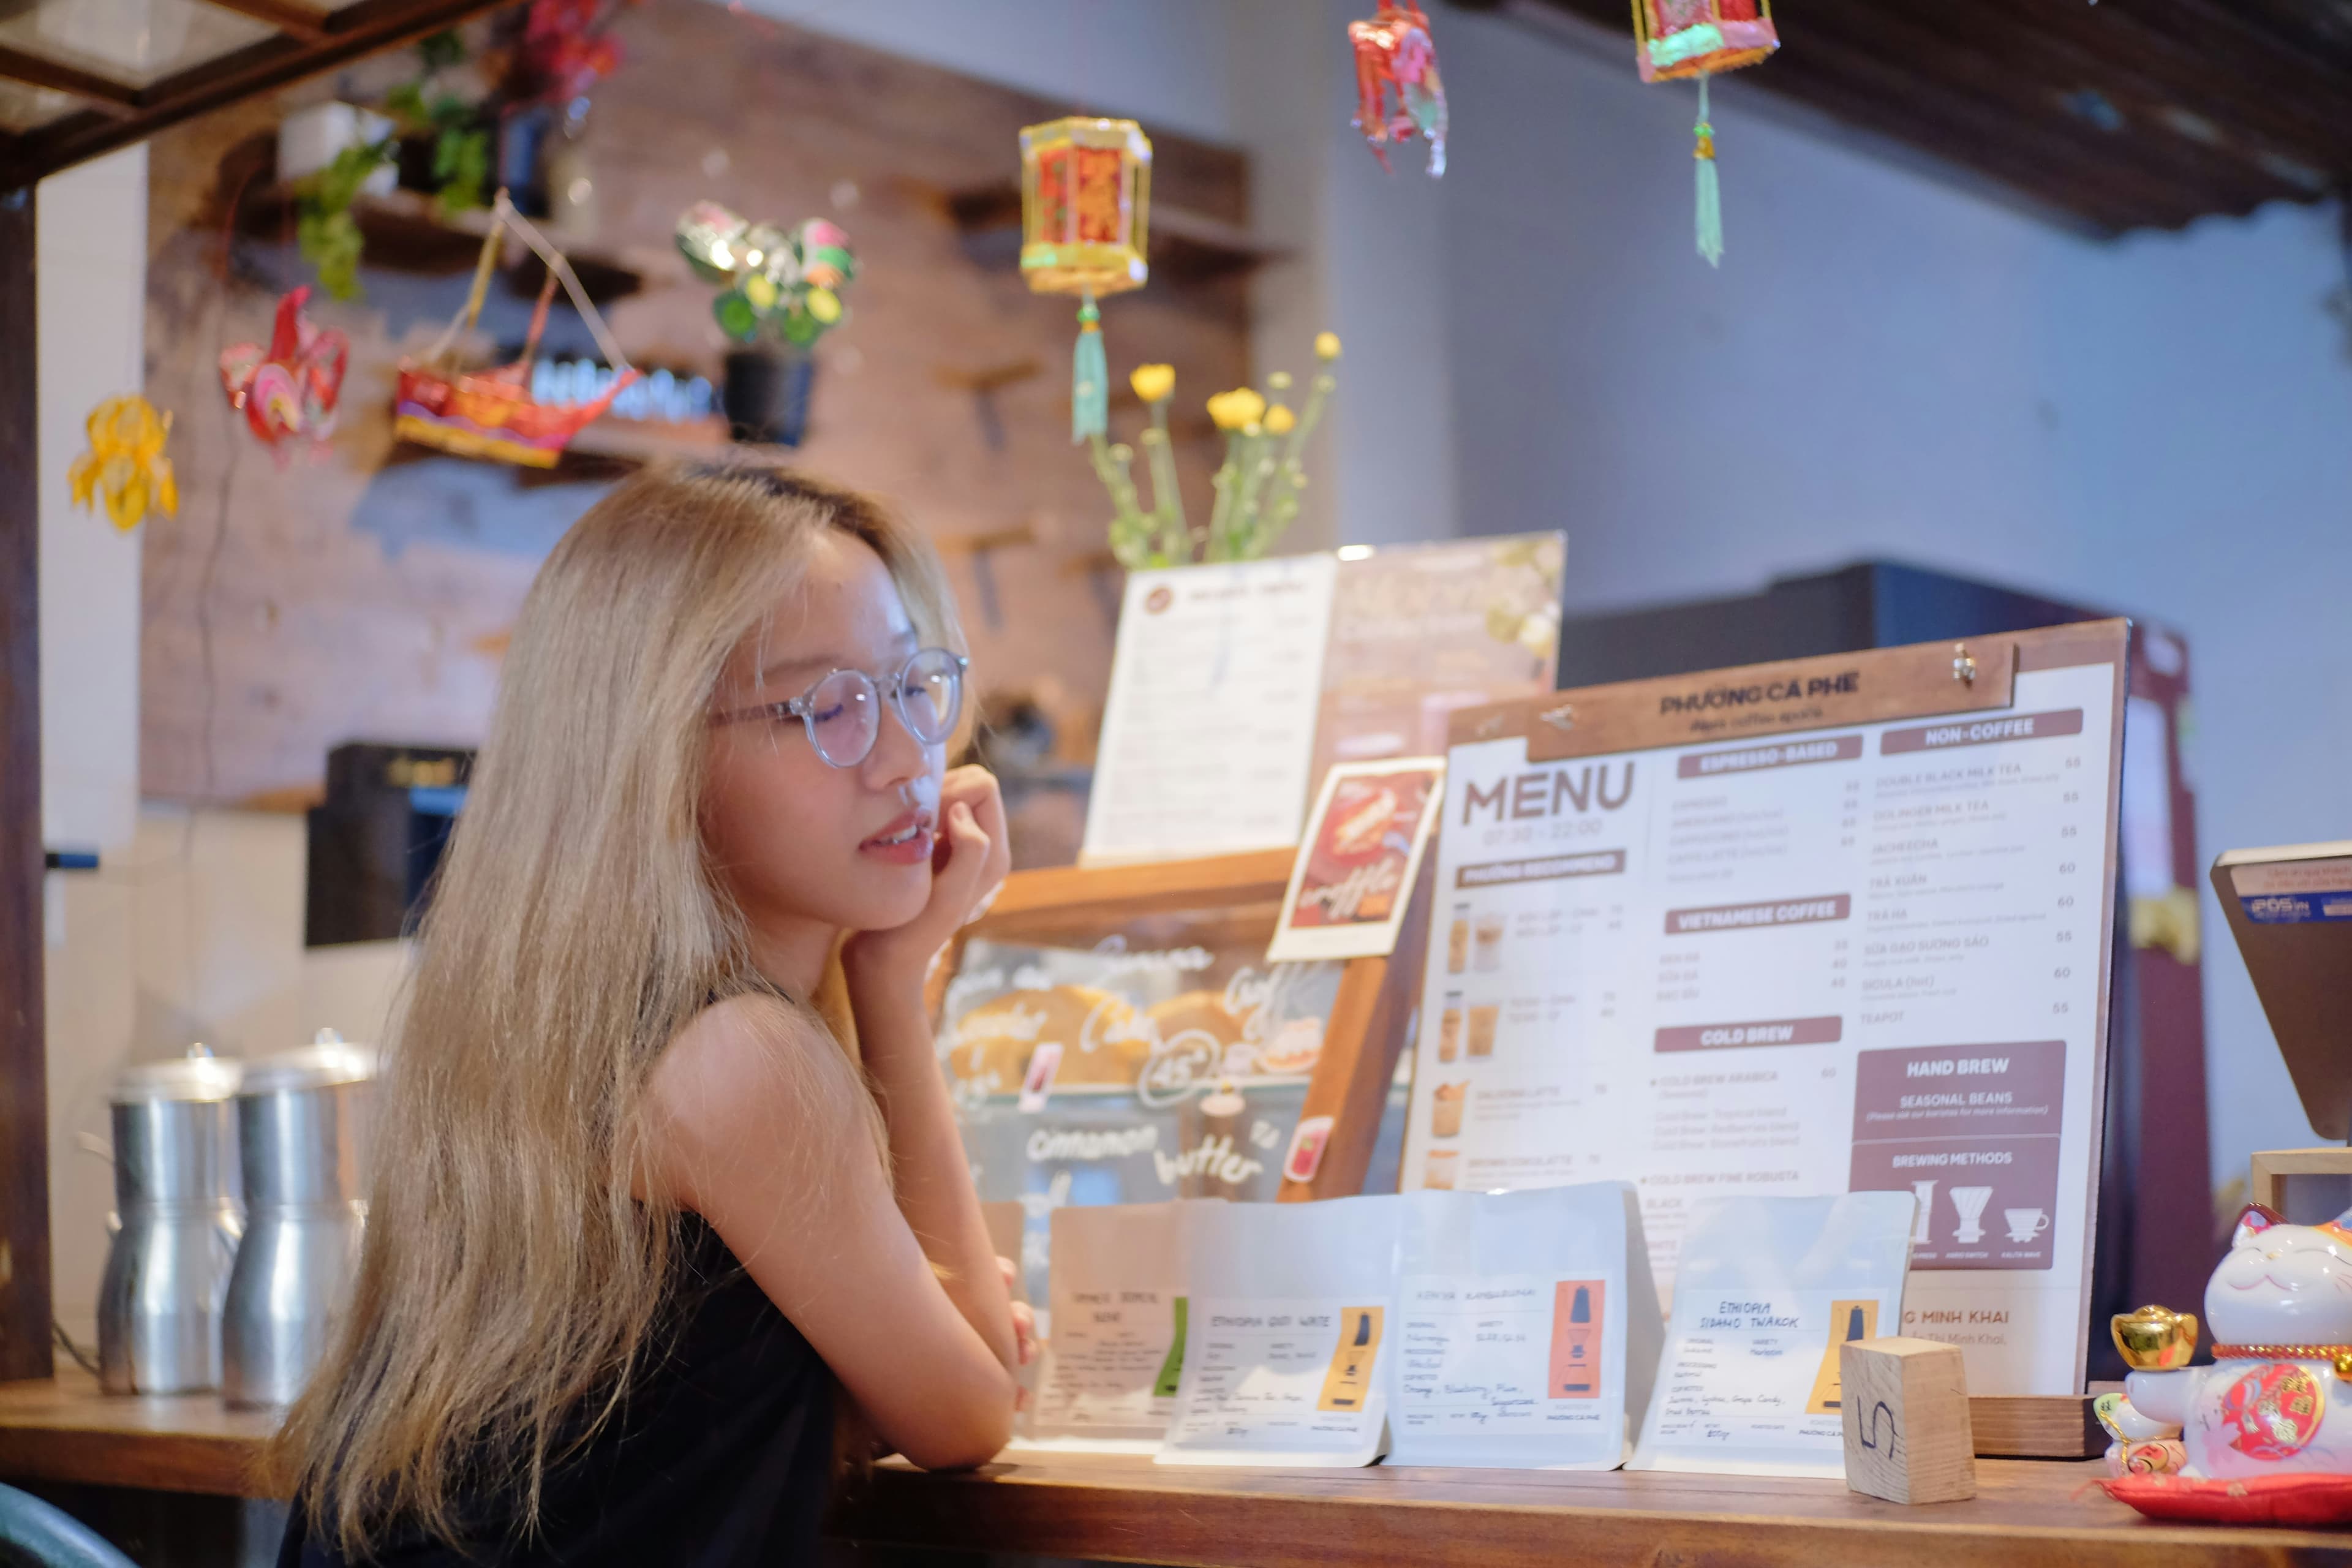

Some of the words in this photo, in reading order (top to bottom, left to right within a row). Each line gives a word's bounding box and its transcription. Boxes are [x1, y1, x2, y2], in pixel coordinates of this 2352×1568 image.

[1925, 717, 2035, 745] NON-COFFEE
[1998, 763, 2022, 775] TEA
[1461, 762, 1635, 827] MENU
[1966, 799, 1989, 812] TEA
[1679, 907, 1775, 930] VIETNAMESE
[1777, 901, 1838, 919] COFFEE
[1700, 1027, 1744, 1046] COLD
[1747, 1023, 1795, 1041] BREW
[1907, 1059, 1954, 1078] HAND
[1957, 1057, 2010, 1076] BREW
[1900, 1092, 1966, 1109] SEASONAL
[1969, 1090, 2014, 1106] BEANS
[1154, 1134, 1264, 1185] butter
[1893, 1153, 1948, 1169] BREWING
[1950, 1151, 2013, 1166] METHODS
[1719, 1300, 1772, 1315] ETHIOPIA
[1921, 1310, 1962, 1324] MINH
[1969, 1310, 2010, 1324] KHAI
[1948, 1333, 1976, 1345] Minh
